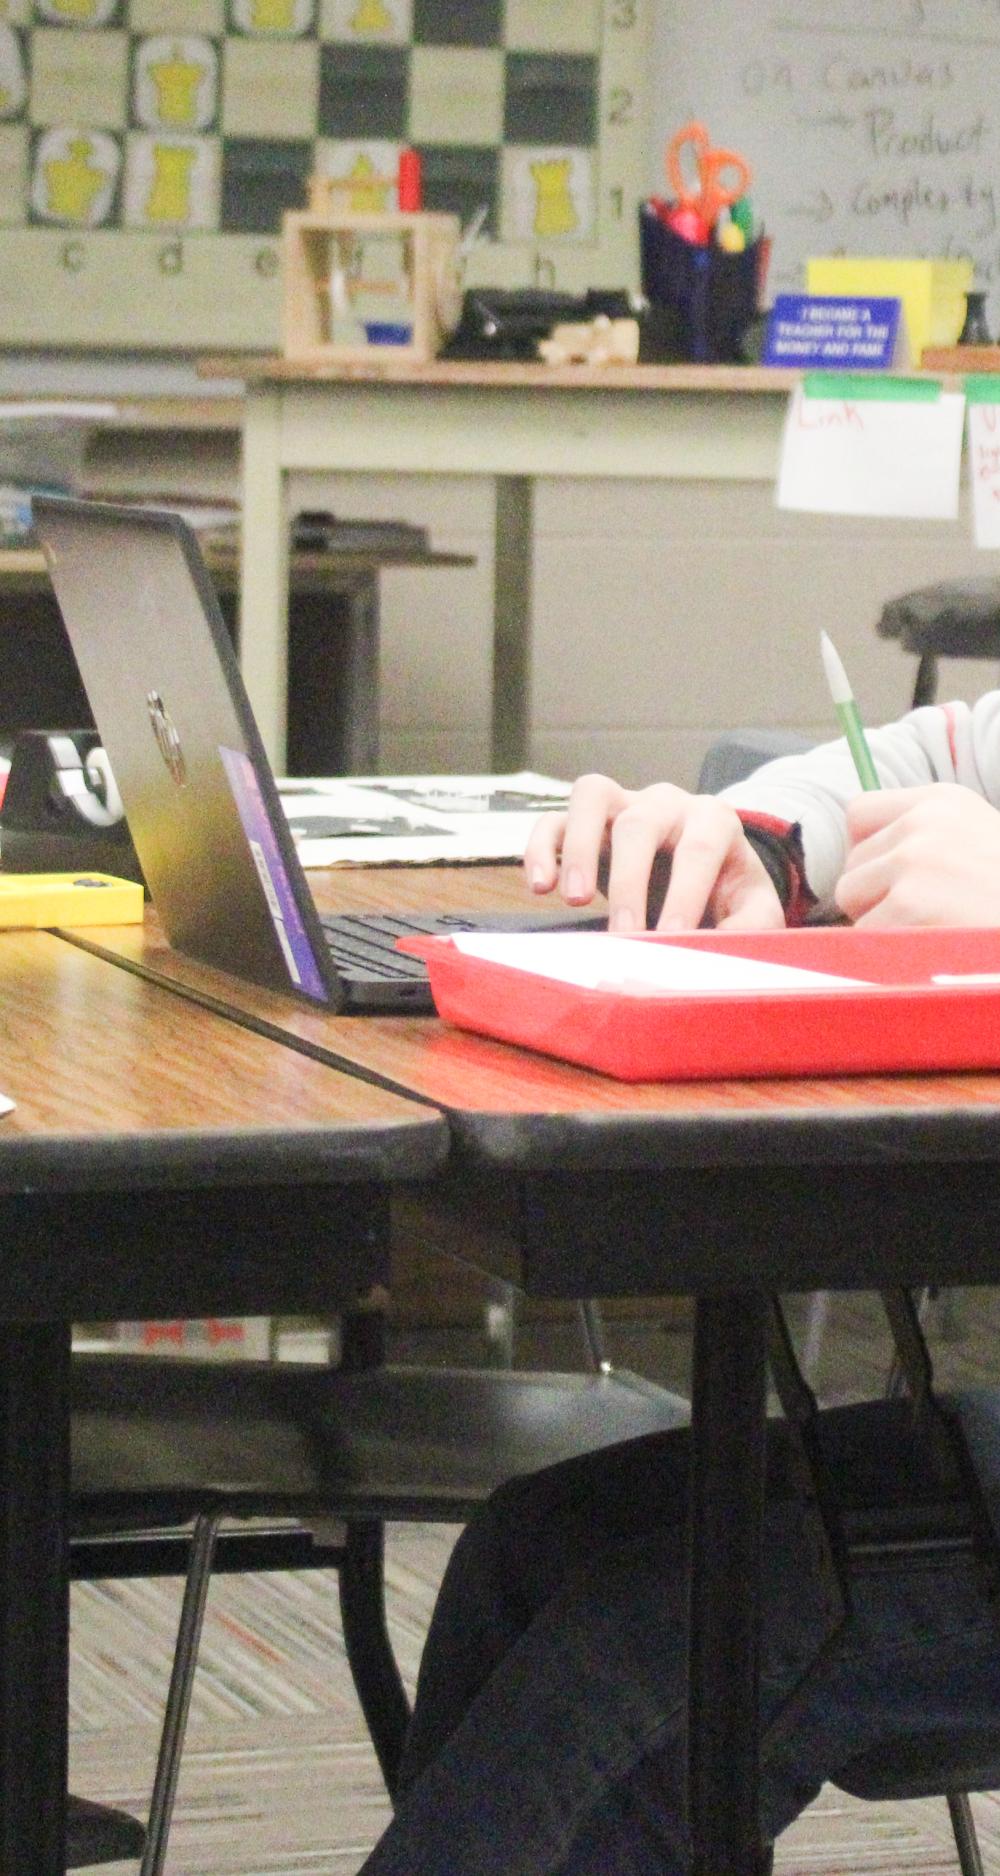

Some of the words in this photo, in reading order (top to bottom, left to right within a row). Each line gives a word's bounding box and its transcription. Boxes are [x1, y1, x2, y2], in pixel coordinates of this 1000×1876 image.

[608, 85, 633, 126] 2
[863, 104, 988, 156] Product
[156, 236, 184, 276] d
[774, 340, 819, 355] MONEY
[823, 341, 849, 356] AND
[777, 320, 834, 338] TEACHER
[837, 322, 862, 338] FOR
